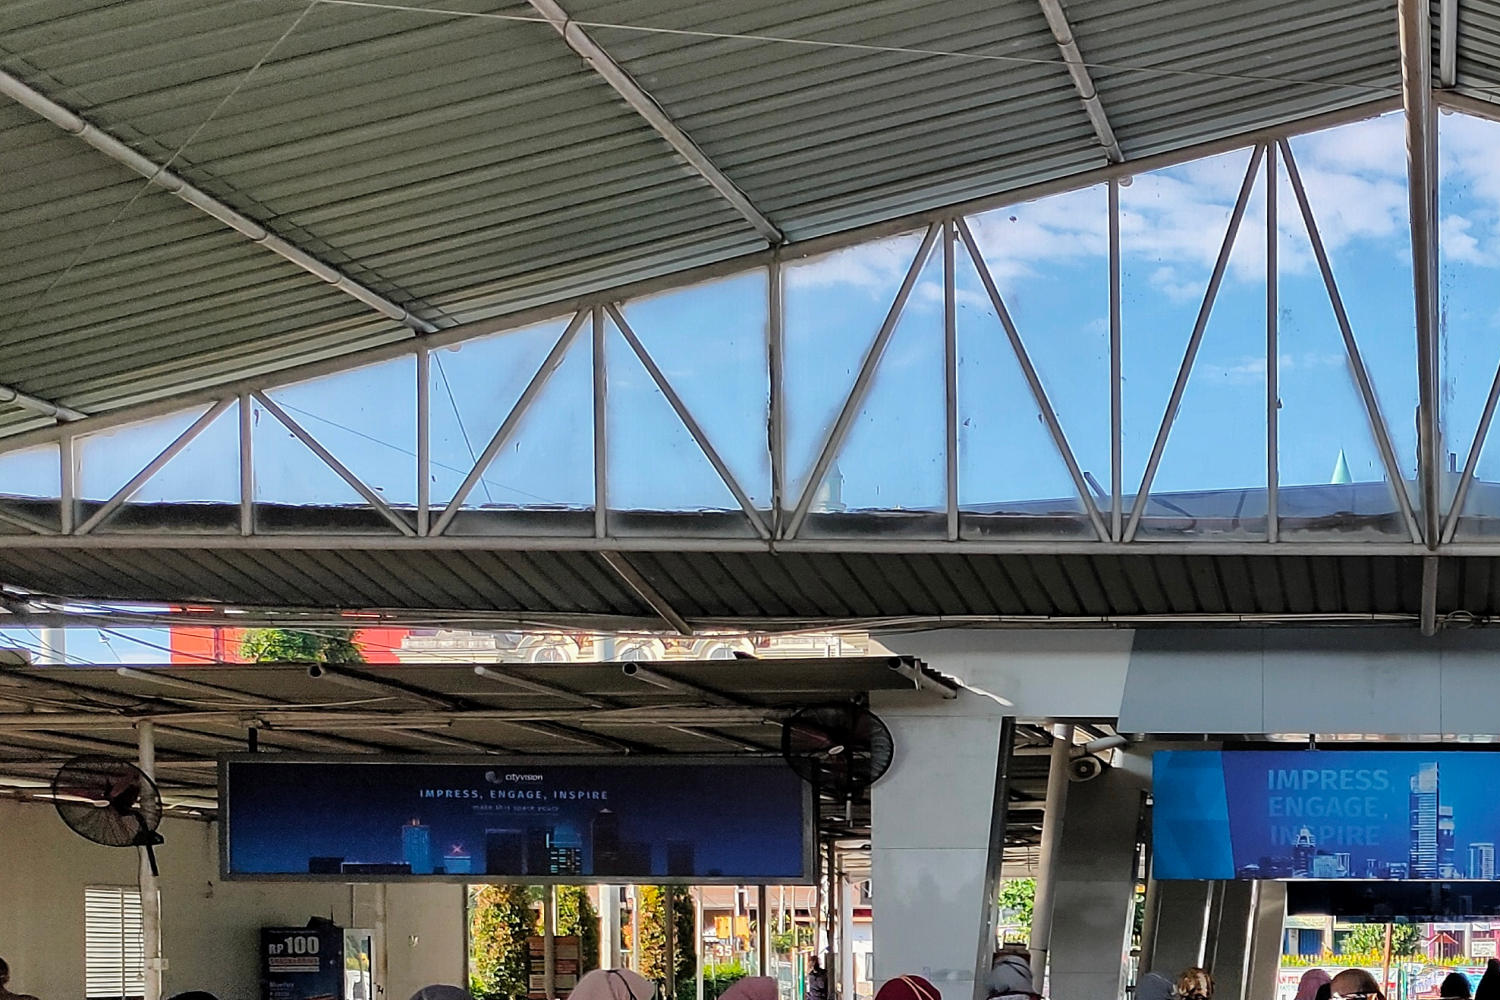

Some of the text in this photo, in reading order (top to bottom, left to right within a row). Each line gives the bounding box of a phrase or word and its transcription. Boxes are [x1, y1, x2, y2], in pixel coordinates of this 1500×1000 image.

[505, 773, 543, 783] cityvision
[1268, 769, 1395, 793] IMPRESS,
[419, 789, 608, 800] IMPRESS, ENGAGE, INSPIRE
[1268, 796, 1388, 820] ENGAGE,
[268, 936, 320, 955] RP 100
[715, 945, 732, 957] 35
